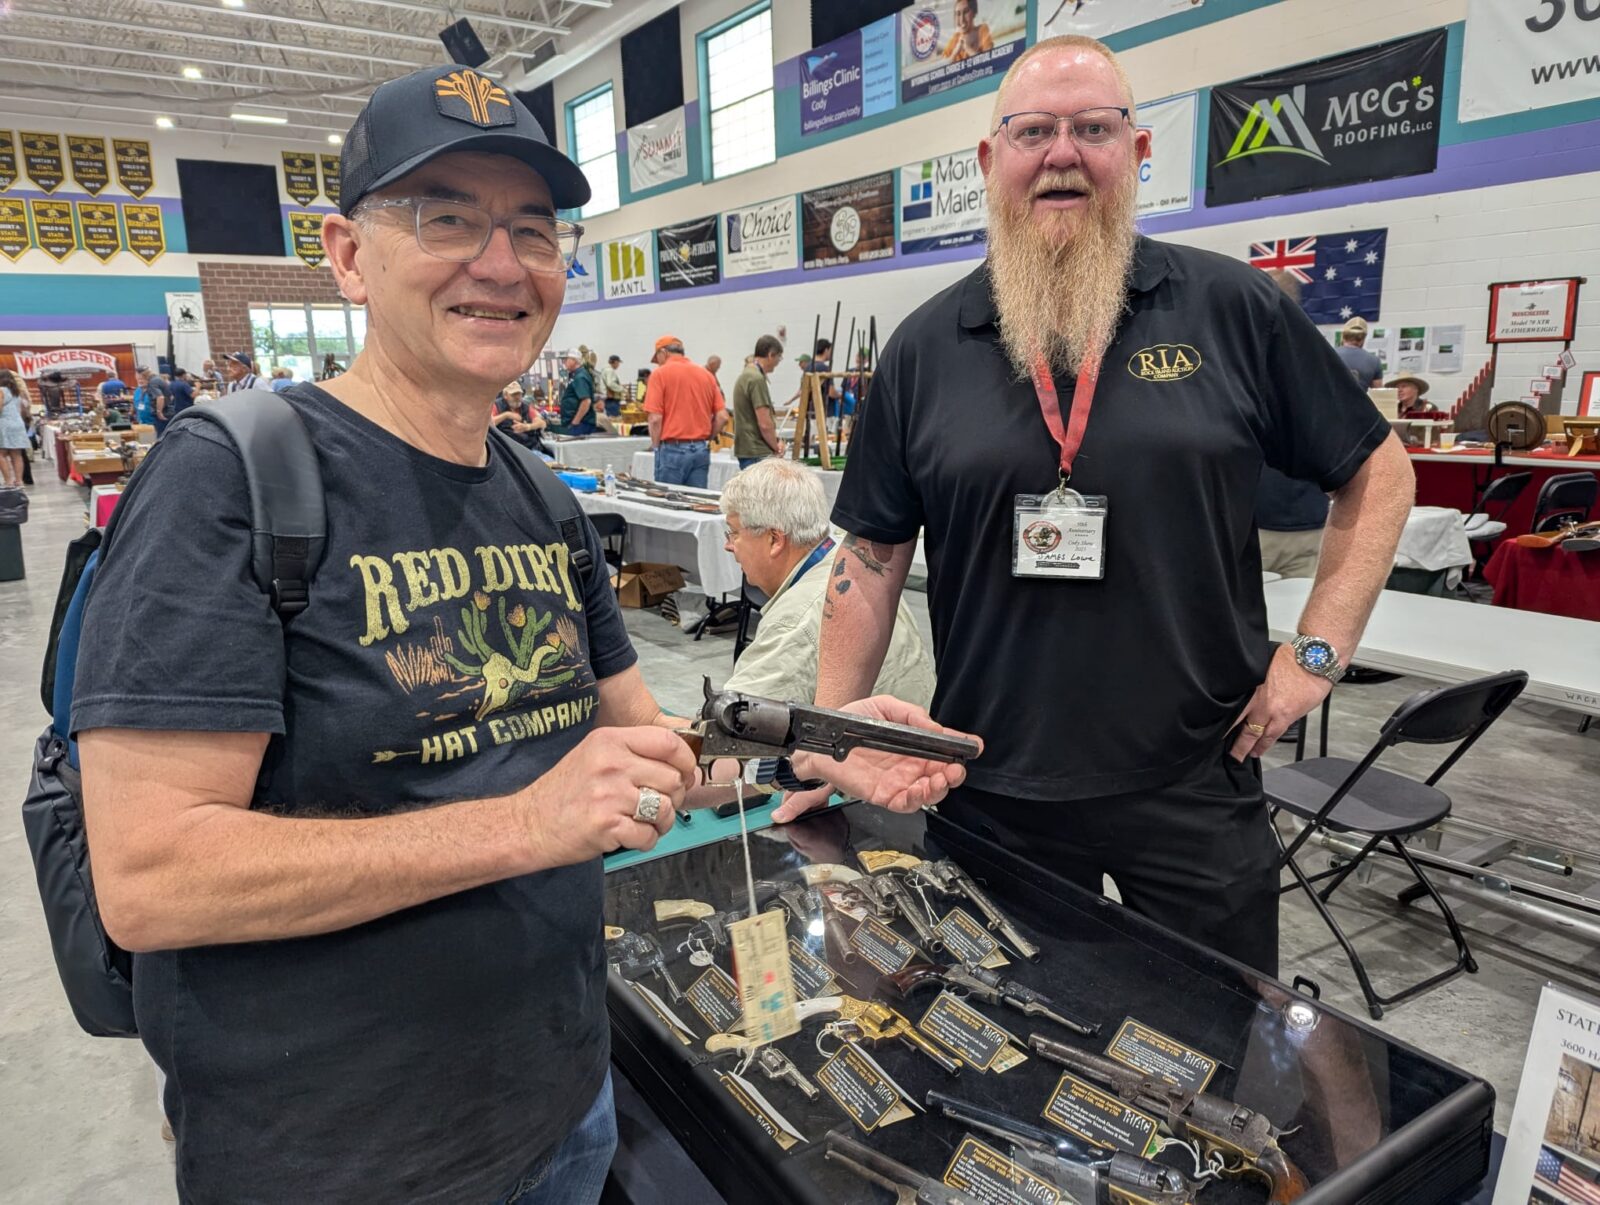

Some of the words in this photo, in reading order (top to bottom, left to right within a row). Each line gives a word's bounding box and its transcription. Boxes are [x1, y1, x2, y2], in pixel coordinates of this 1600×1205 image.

[803, 78, 833, 99] Billings
[834, 65, 860, 87] Clinic
[811, 98, 827, 112] Cody
[1321, 79, 1435, 131] McG's
[742, 206, 792, 239] Choice
[611, 280, 646, 297] MANTL
[1501, 326, 1558, 334] FEATHERWEIGHT
[18, 351, 114, 377] WINCHESTER
[1138, 348, 1193, 370] RIA
[350, 547, 471, 647] RED
[474, 542, 583, 612] DIRT
[421, 726, 479, 764] HAT
[488, 696, 594, 745] COMPANY
[1560, 1038, 1585, 1055] 3600
